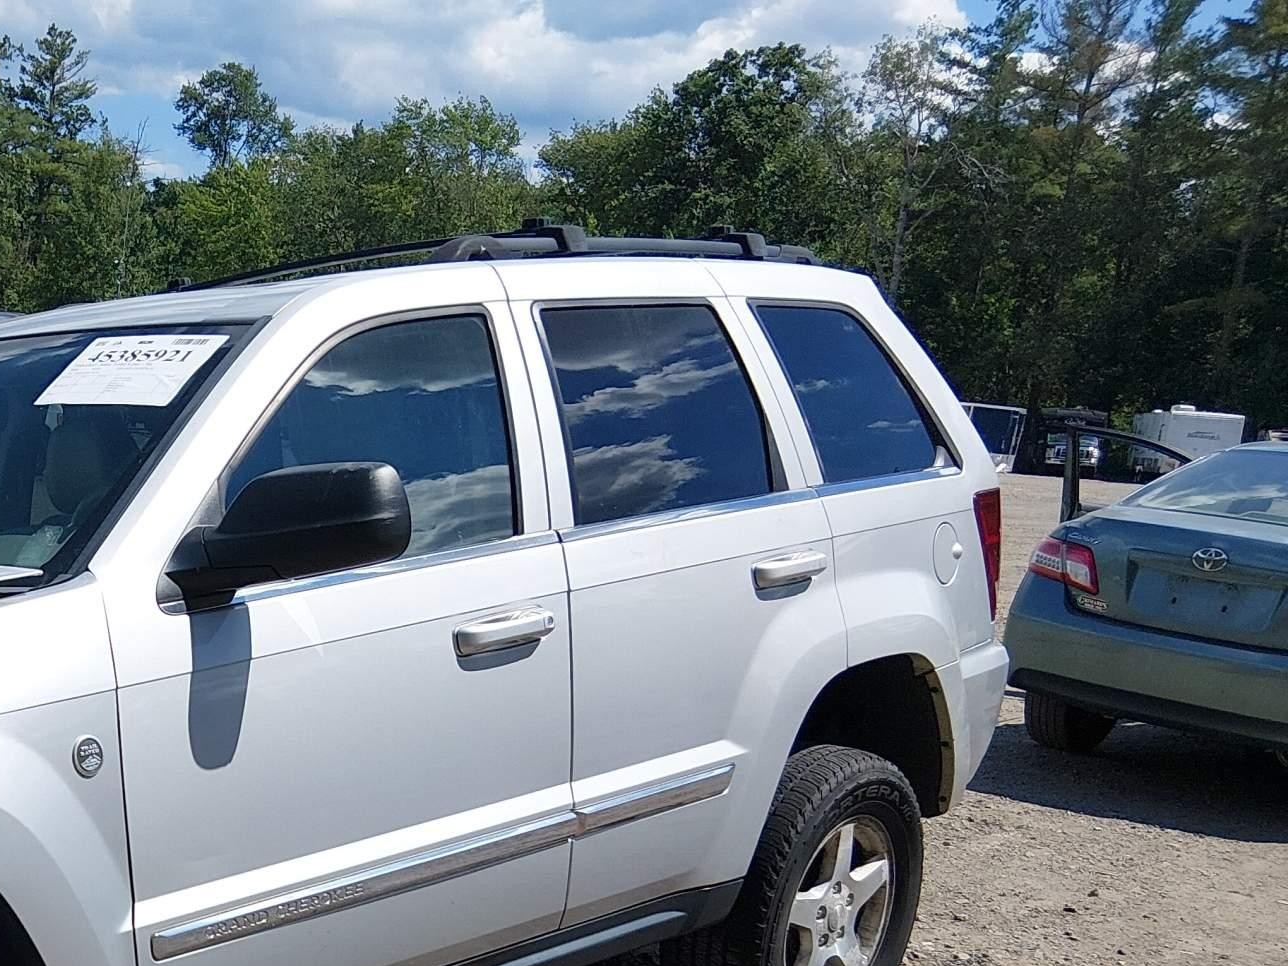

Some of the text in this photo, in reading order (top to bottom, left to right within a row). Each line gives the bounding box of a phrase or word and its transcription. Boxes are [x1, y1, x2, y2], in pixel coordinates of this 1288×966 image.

[87, 349, 194, 363] 45385921
[203, 882, 366, 940] GRAND CHEROKEE
